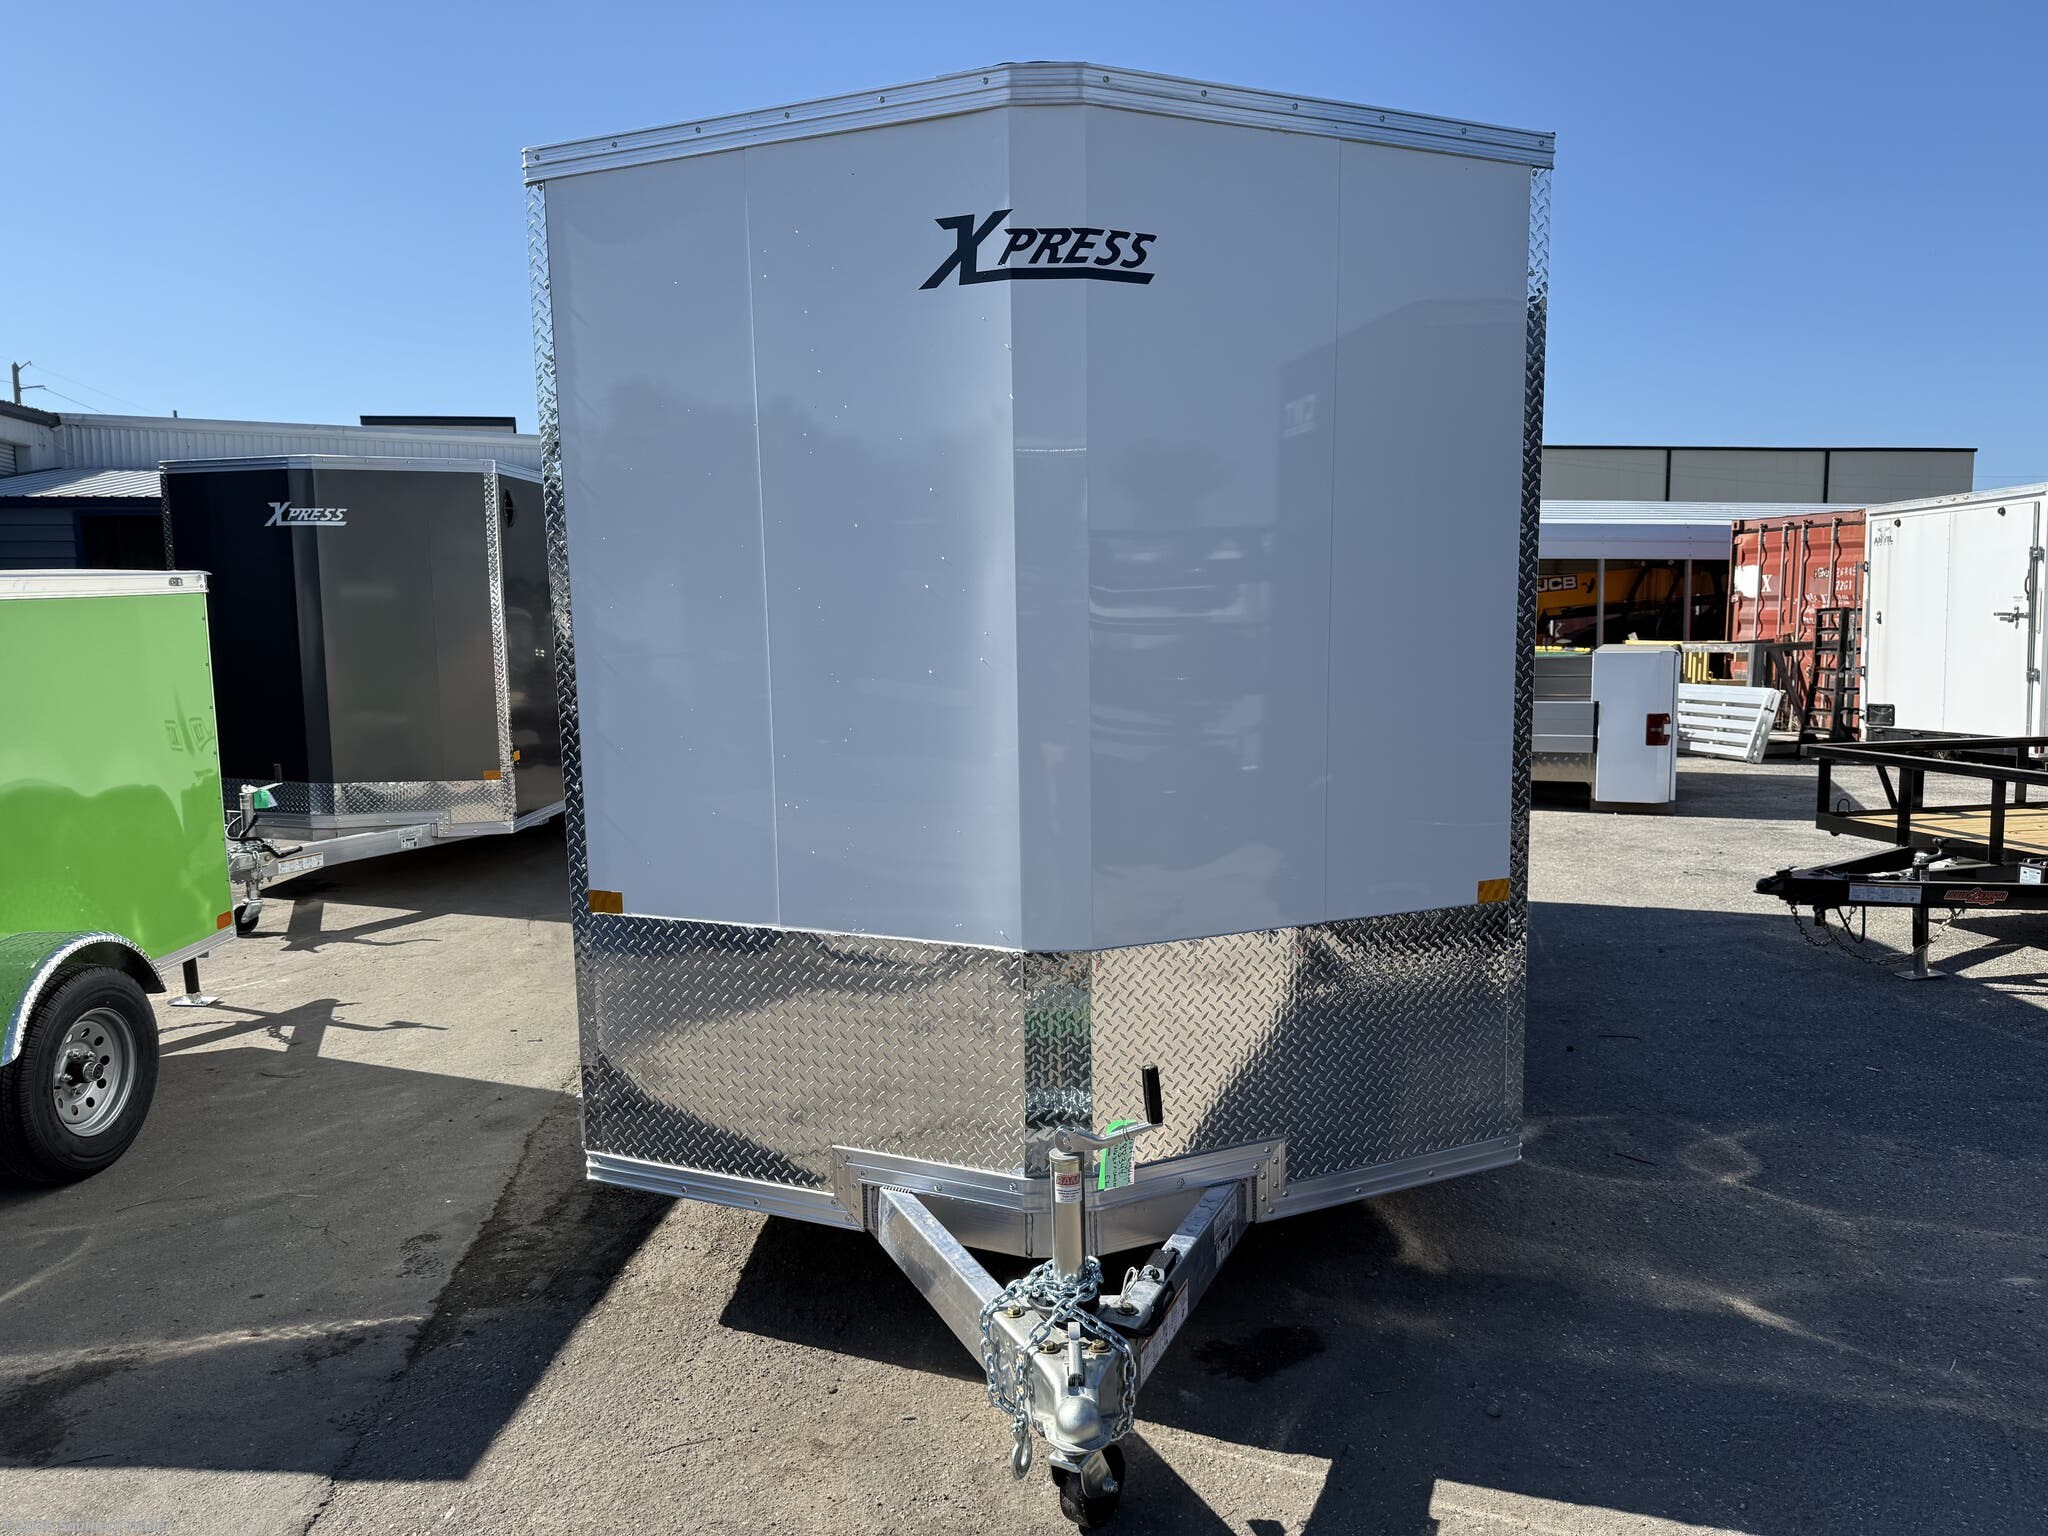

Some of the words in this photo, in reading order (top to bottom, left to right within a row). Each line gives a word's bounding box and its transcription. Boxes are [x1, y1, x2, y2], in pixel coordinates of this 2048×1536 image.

[918, 208, 1157, 290] XPRESS
[264, 501, 347, 526] XPRESS
[1538, 576, 1577, 592] JCB
